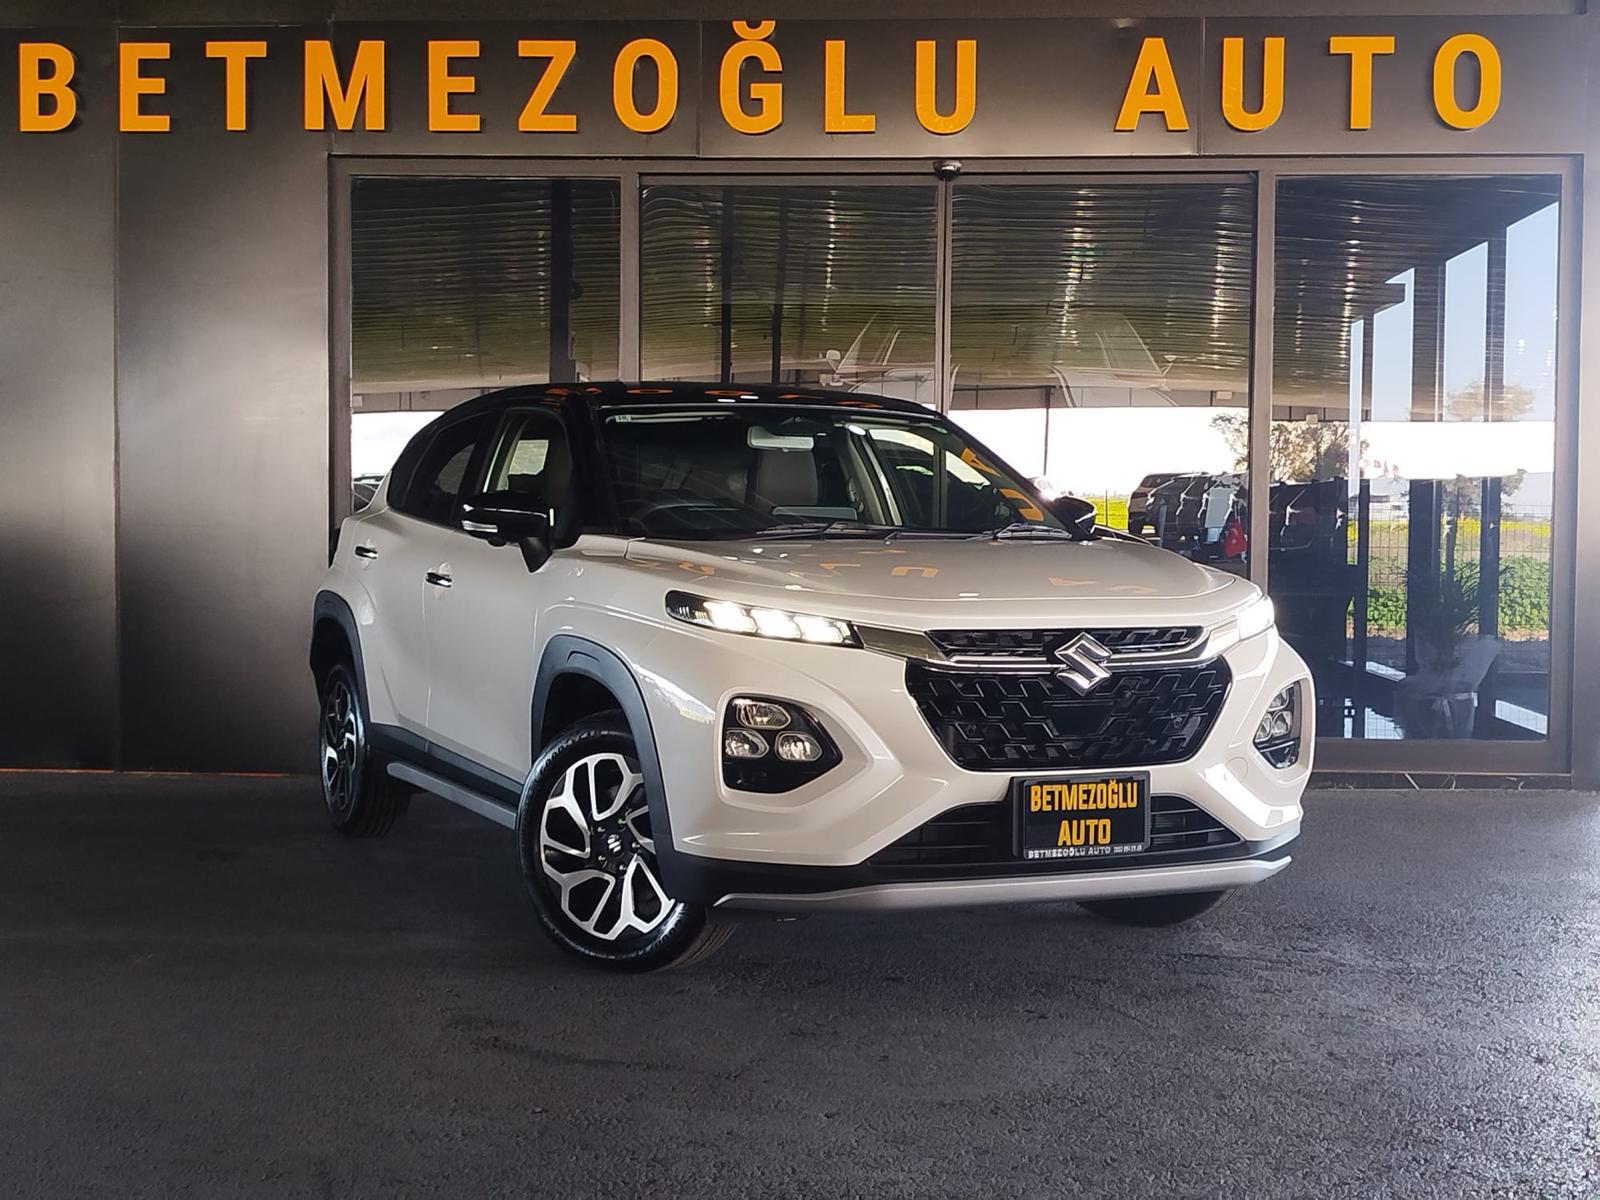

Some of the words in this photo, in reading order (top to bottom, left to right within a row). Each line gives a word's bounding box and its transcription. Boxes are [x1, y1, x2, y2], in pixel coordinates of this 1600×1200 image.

[19, 20, 977, 134] BETMEZOĞLU
[1115, 33, 1501, 131] AUTO
[1030, 778, 1138, 812] BETMEZOĞLU
[1057, 818, 1111, 846] AUTO
[1088, 846, 1111, 856] AUTO
